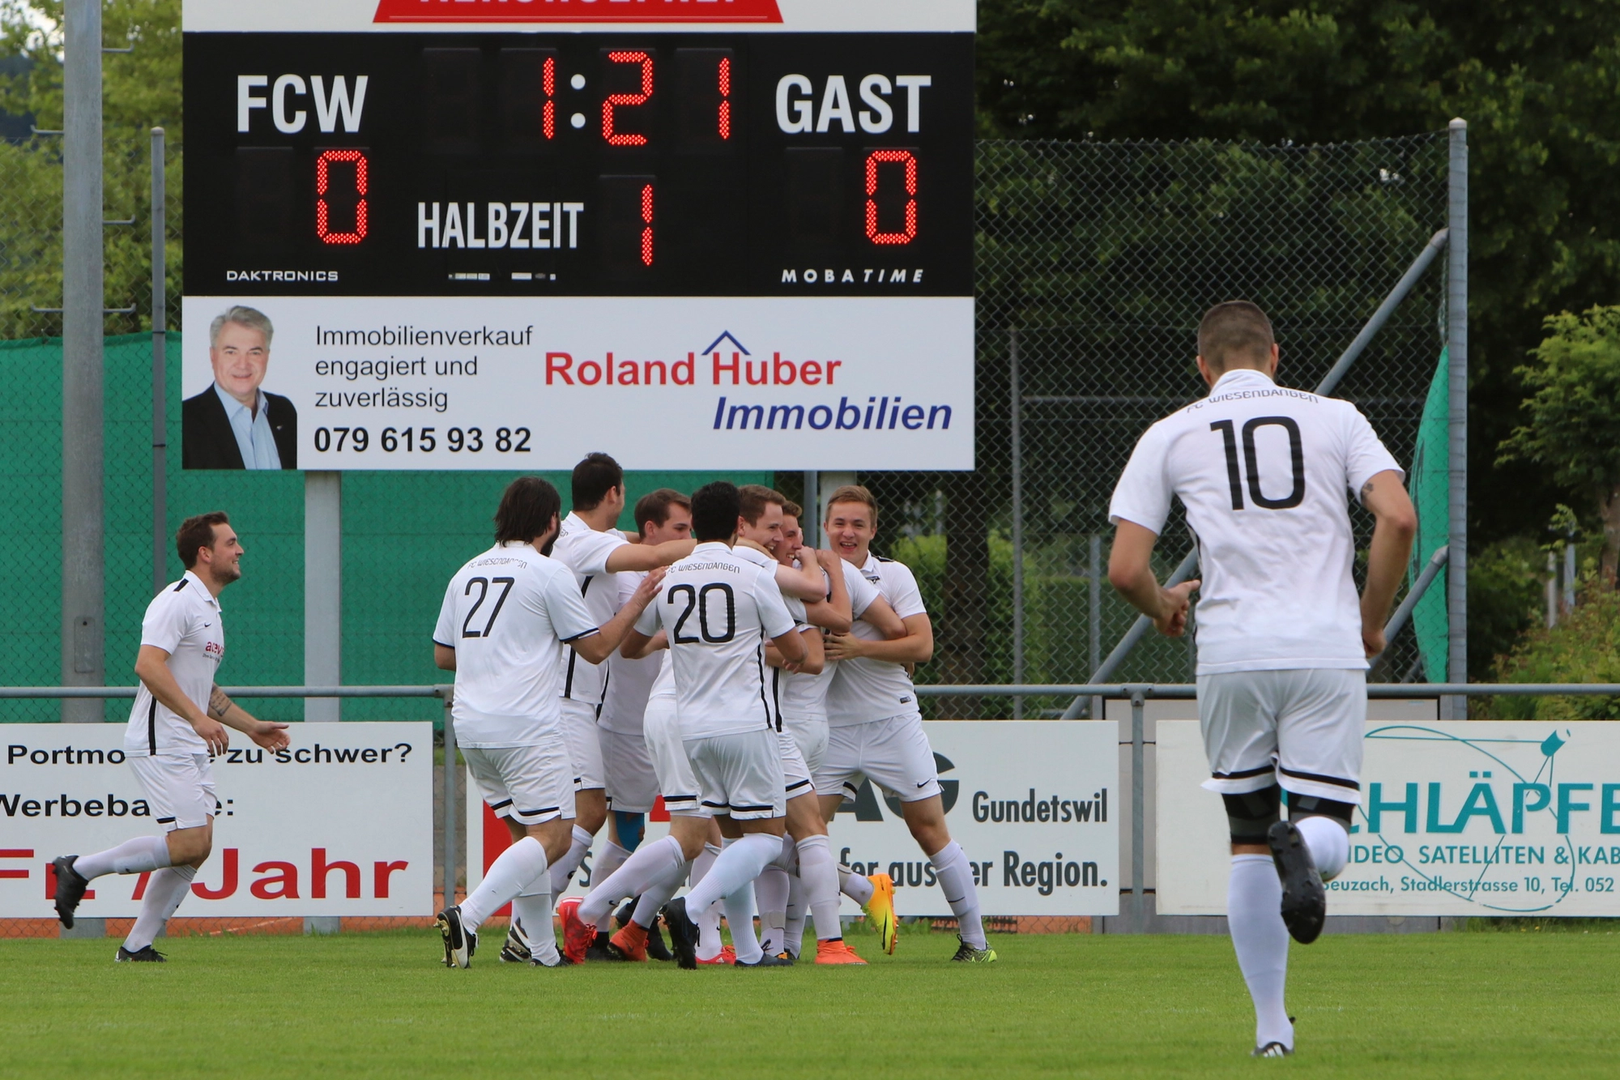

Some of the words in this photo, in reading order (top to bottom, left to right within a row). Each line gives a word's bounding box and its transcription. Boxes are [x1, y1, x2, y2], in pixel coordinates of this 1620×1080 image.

[237, 73, 369, 134] FCW
[775, 73, 932, 134] GAST
[316, 149, 368, 245] 0
[865, 149, 917, 245] 0
[417, 201, 584, 249] HALBZEIT
[641, 183, 653, 266] 1
[226, 269, 339, 282] DAKTRONICS
[781, 268, 924, 283] MOBATIME
[316, 324, 534, 347] Immobilienverkauf
[314, 355, 427, 381] engagiert
[434, 355, 478, 376] und
[544, 351, 696, 386] Roland
[711, 351, 842, 386] Huber
[314, 387, 449, 413] zuverlässig
[713, 396, 952, 431] Immobilien
[313, 426, 370, 453] 079
[380, 426, 437, 453] 615
[447, 426, 484, 453] 93
[495, 426, 532, 453] 82
[1209, 415, 1306, 511] 10
[461, 576, 515, 639] 27
[667, 582, 736, 644] 20
[226, 748, 263, 764] zu
[274, 742, 413, 764] schwer?
[972, 787, 1108, 823] Gundetswil
[1346, 844, 1405, 865] IDEO
[1418, 844, 1546, 865] SATELLITEN
[1553, 845, 1571, 865] &
[190, 847, 410, 901] Jahr
[1002, 850, 1108, 896] Region.
[1400, 874, 1519, 893] Stadlerstrasse
[1523, 876, 1546, 895] 10,
[1551, 876, 1579, 893] Tel.
[1584, 876, 1615, 893] 052
